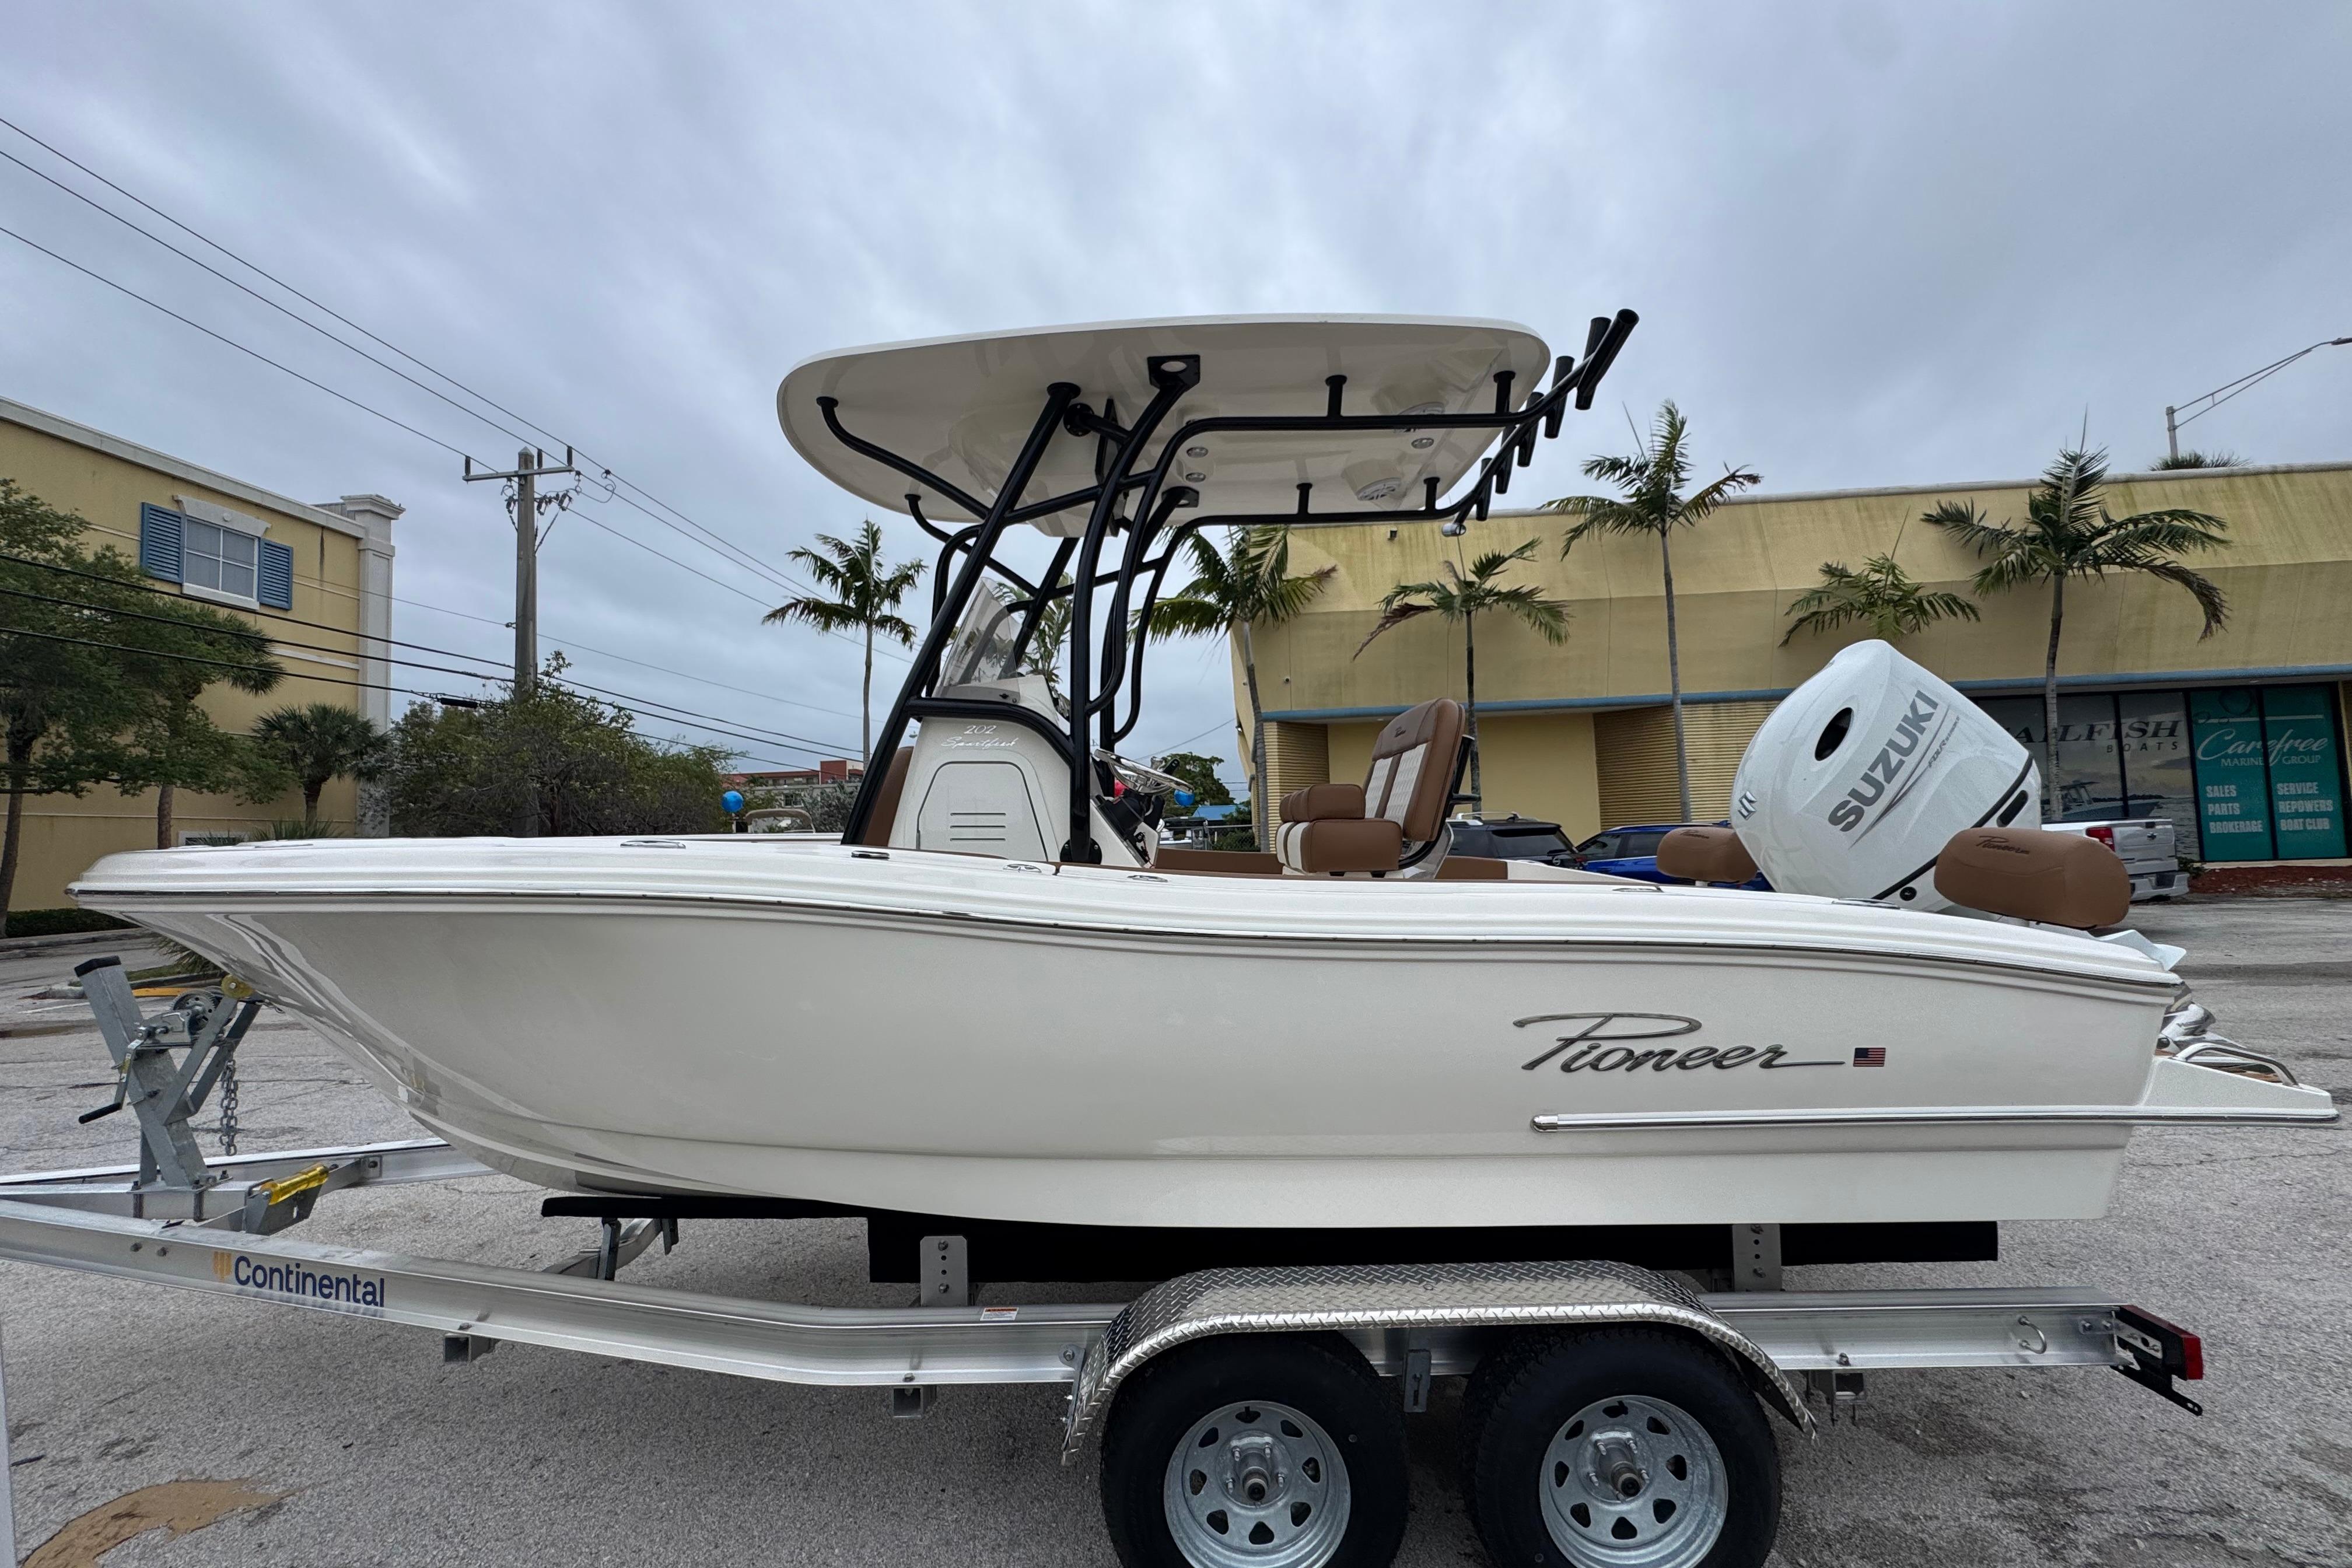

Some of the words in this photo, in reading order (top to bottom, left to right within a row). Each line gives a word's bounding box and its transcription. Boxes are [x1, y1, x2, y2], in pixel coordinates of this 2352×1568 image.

[964, 725, 997, 734] 202
[2106, 741, 2178, 753] BOATS
[2197, 729, 2328, 766] Carefree
[1828, 690, 1939, 832] SUZUKI
[2221, 757, 2264, 766] MARINE
[2282, 755, 2321, 765] GROUP
[2206, 785, 2236, 797] SALES
[2277, 782, 2319, 795] SERVICE
[2207, 803, 2240, 816] PARTS
[2278, 799, 2333, 813] REPOWERS
[2209, 820, 2263, 834] BROKERAGE
[2280, 818, 2304, 831] BOAT
[2305, 818, 2330, 830] CLUB
[1513, 1012, 1845, 1073] Pioneer
[235, 1255, 385, 1307] Continental
